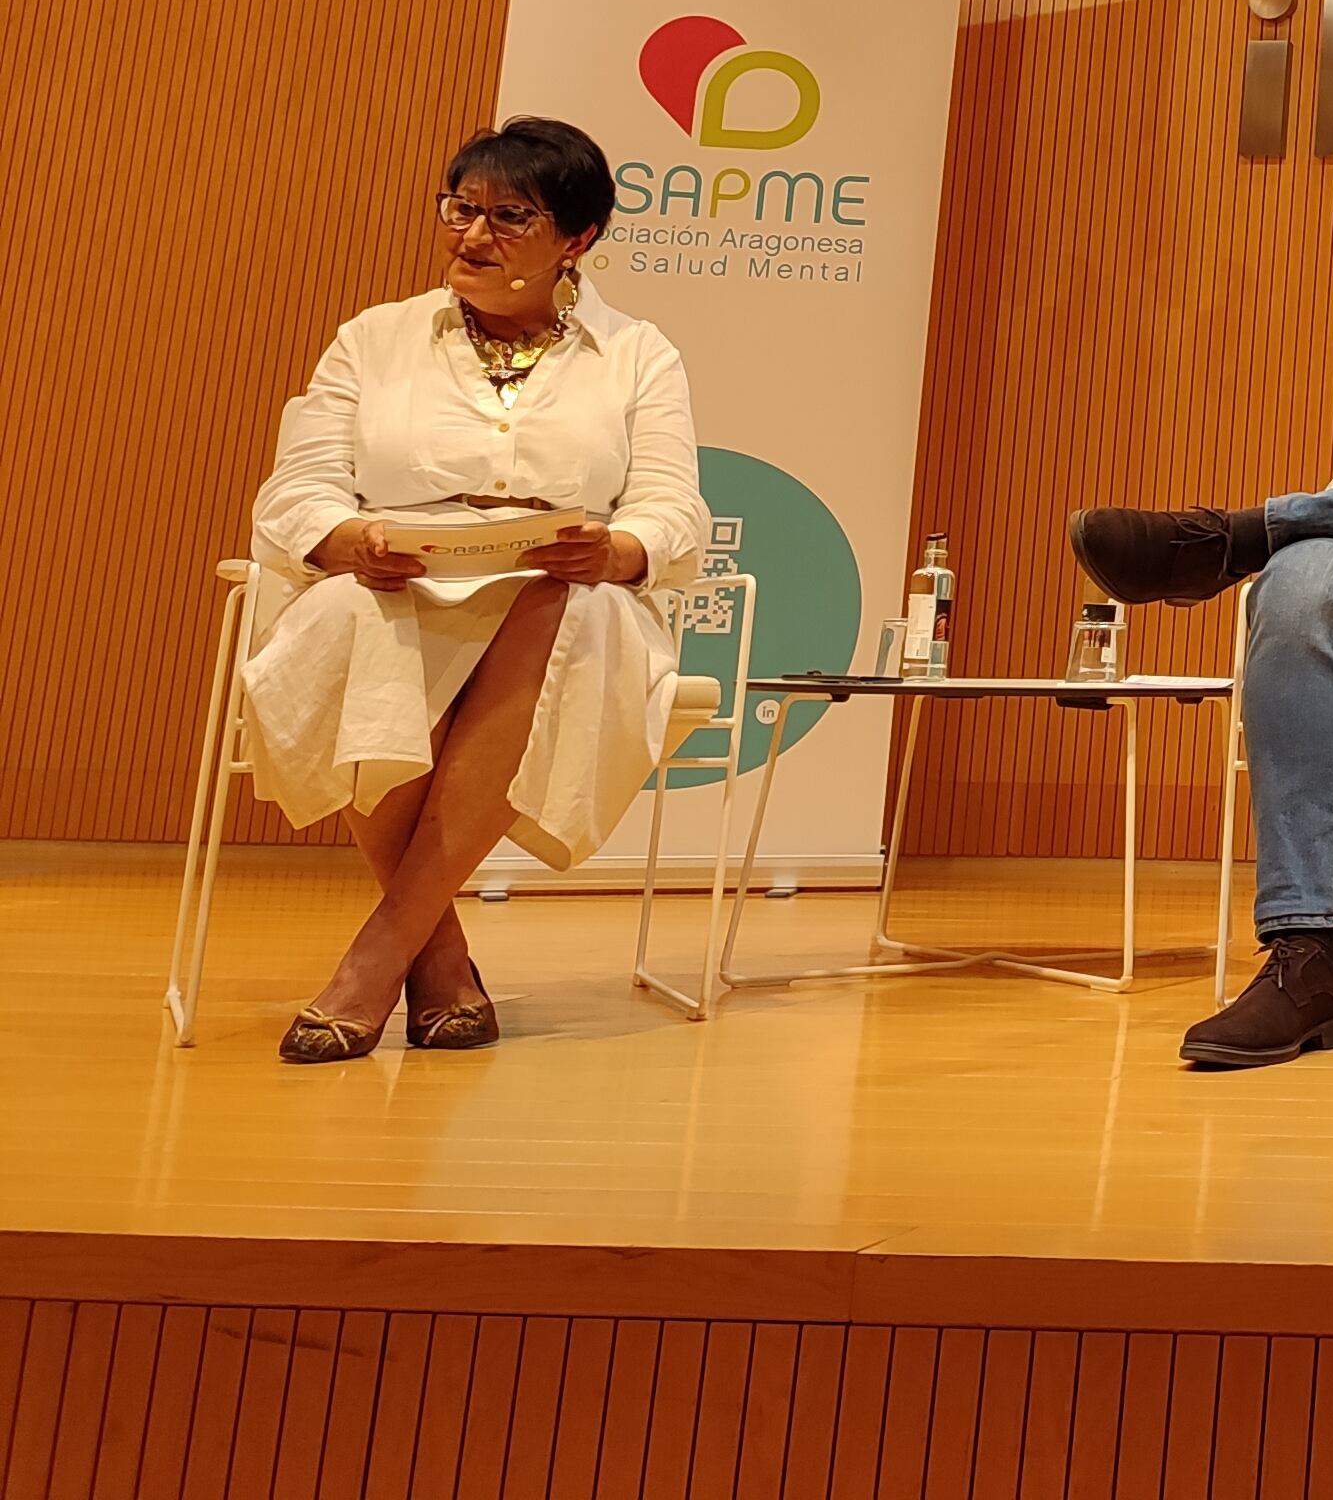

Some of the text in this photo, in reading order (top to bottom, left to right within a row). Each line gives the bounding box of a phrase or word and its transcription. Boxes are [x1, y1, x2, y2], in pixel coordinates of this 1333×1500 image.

[613, 162, 870, 226] SAPME
[719, 228, 864, 257] Aragonesa
[630, 251, 728, 277] Salud
[748, 257, 862, 283] Mental
[762, 705, 775, 719] in
